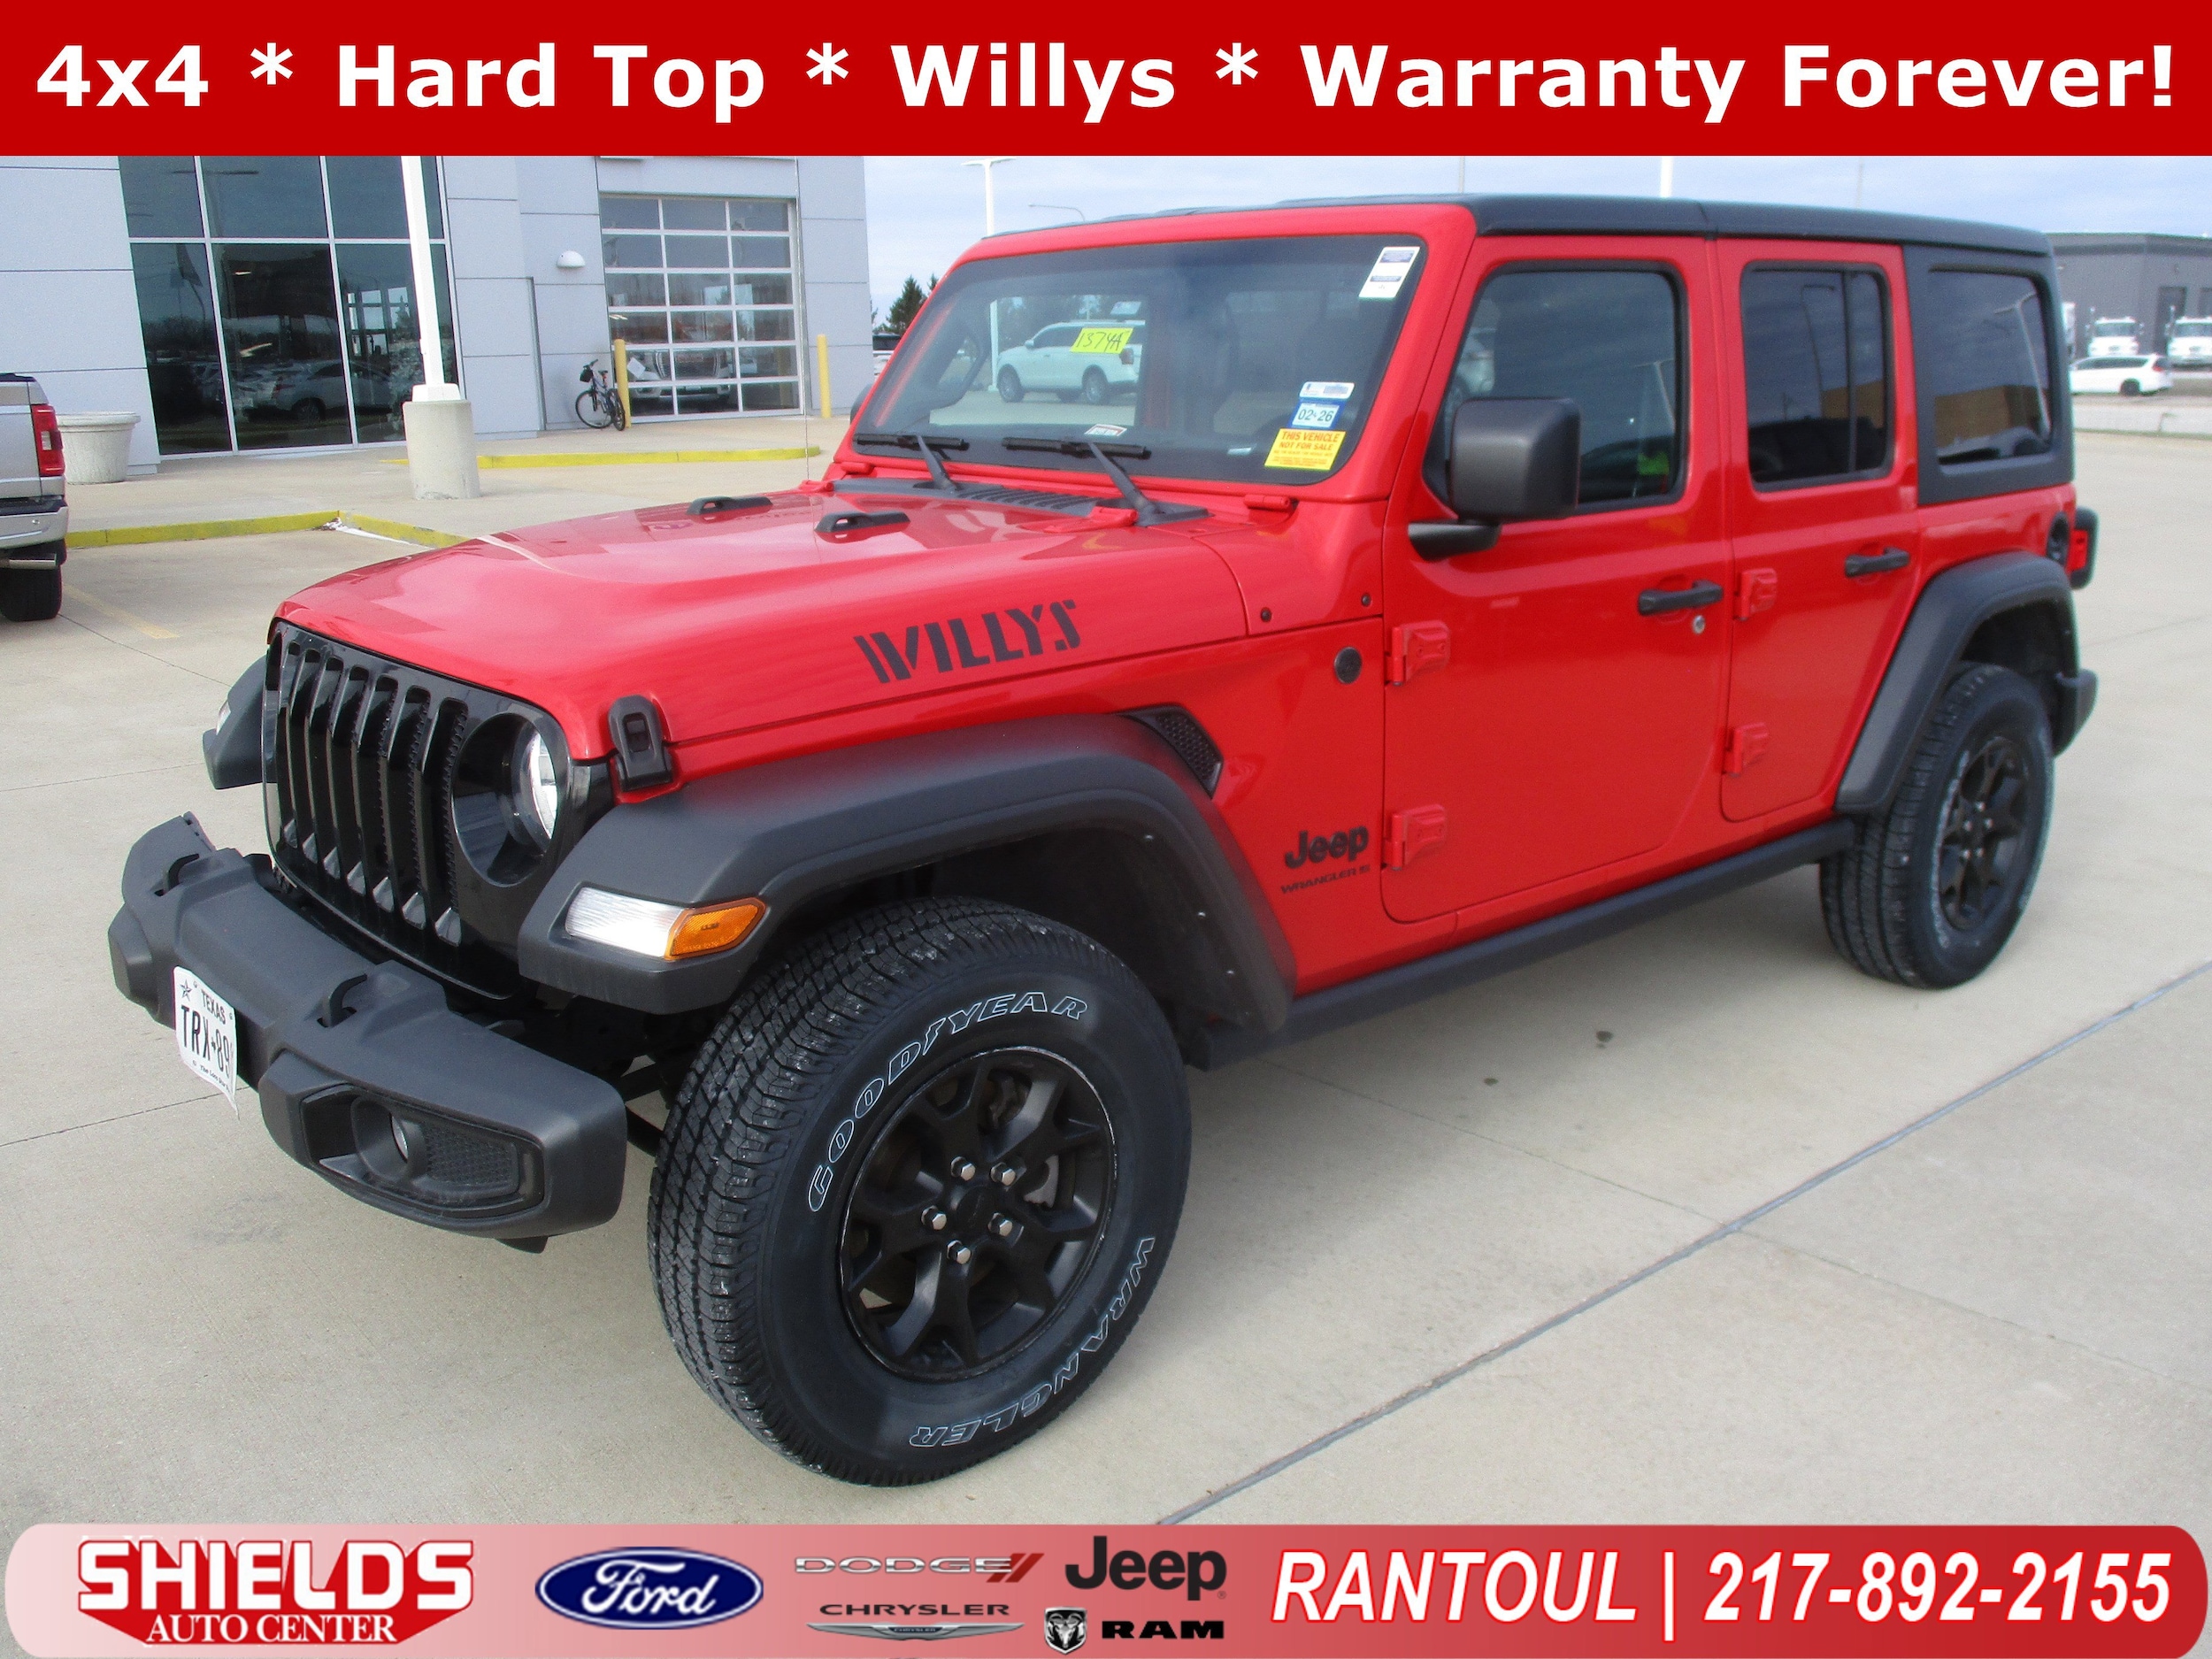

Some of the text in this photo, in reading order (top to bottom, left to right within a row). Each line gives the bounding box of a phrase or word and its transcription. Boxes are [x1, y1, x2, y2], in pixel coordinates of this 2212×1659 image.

[1282, 432, 1340, 442] THIS VEHICLE
[853, 599, 1080, 683] WILLYS
[1285, 825, 1369, 869] Jeep
[1280, 867, 1357, 894] WRANGLER
[201, 989, 226, 1025] TEXAS
[808, 991, 1088, 1212] GOODYEAR
[910, 1237, 1155, 1448] WRANGLER
